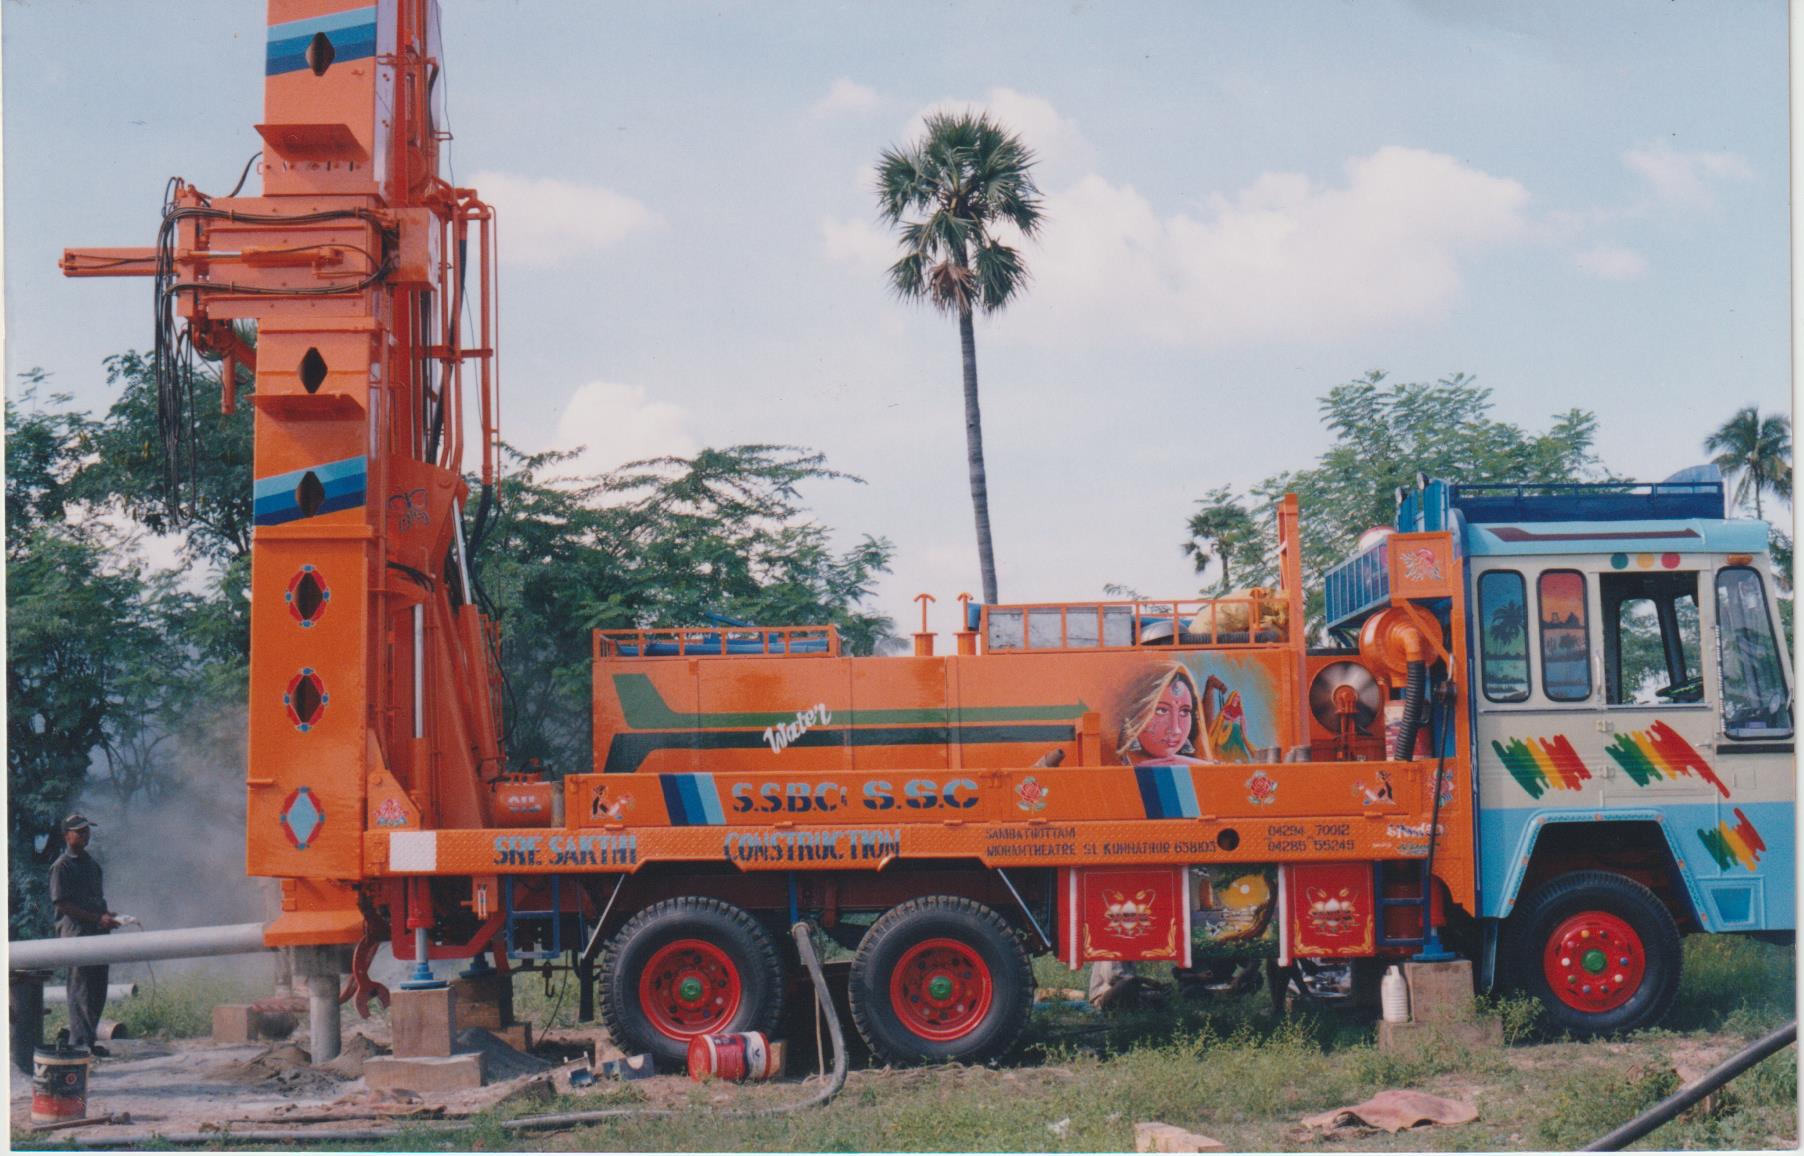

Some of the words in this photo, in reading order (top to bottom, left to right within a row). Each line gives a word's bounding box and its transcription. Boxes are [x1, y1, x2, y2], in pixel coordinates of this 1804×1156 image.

[763, 703, 832, 754] Water
[862, 778, 979, 810] S.S.C
[723, 829, 901, 861] CONSTRUCTION
